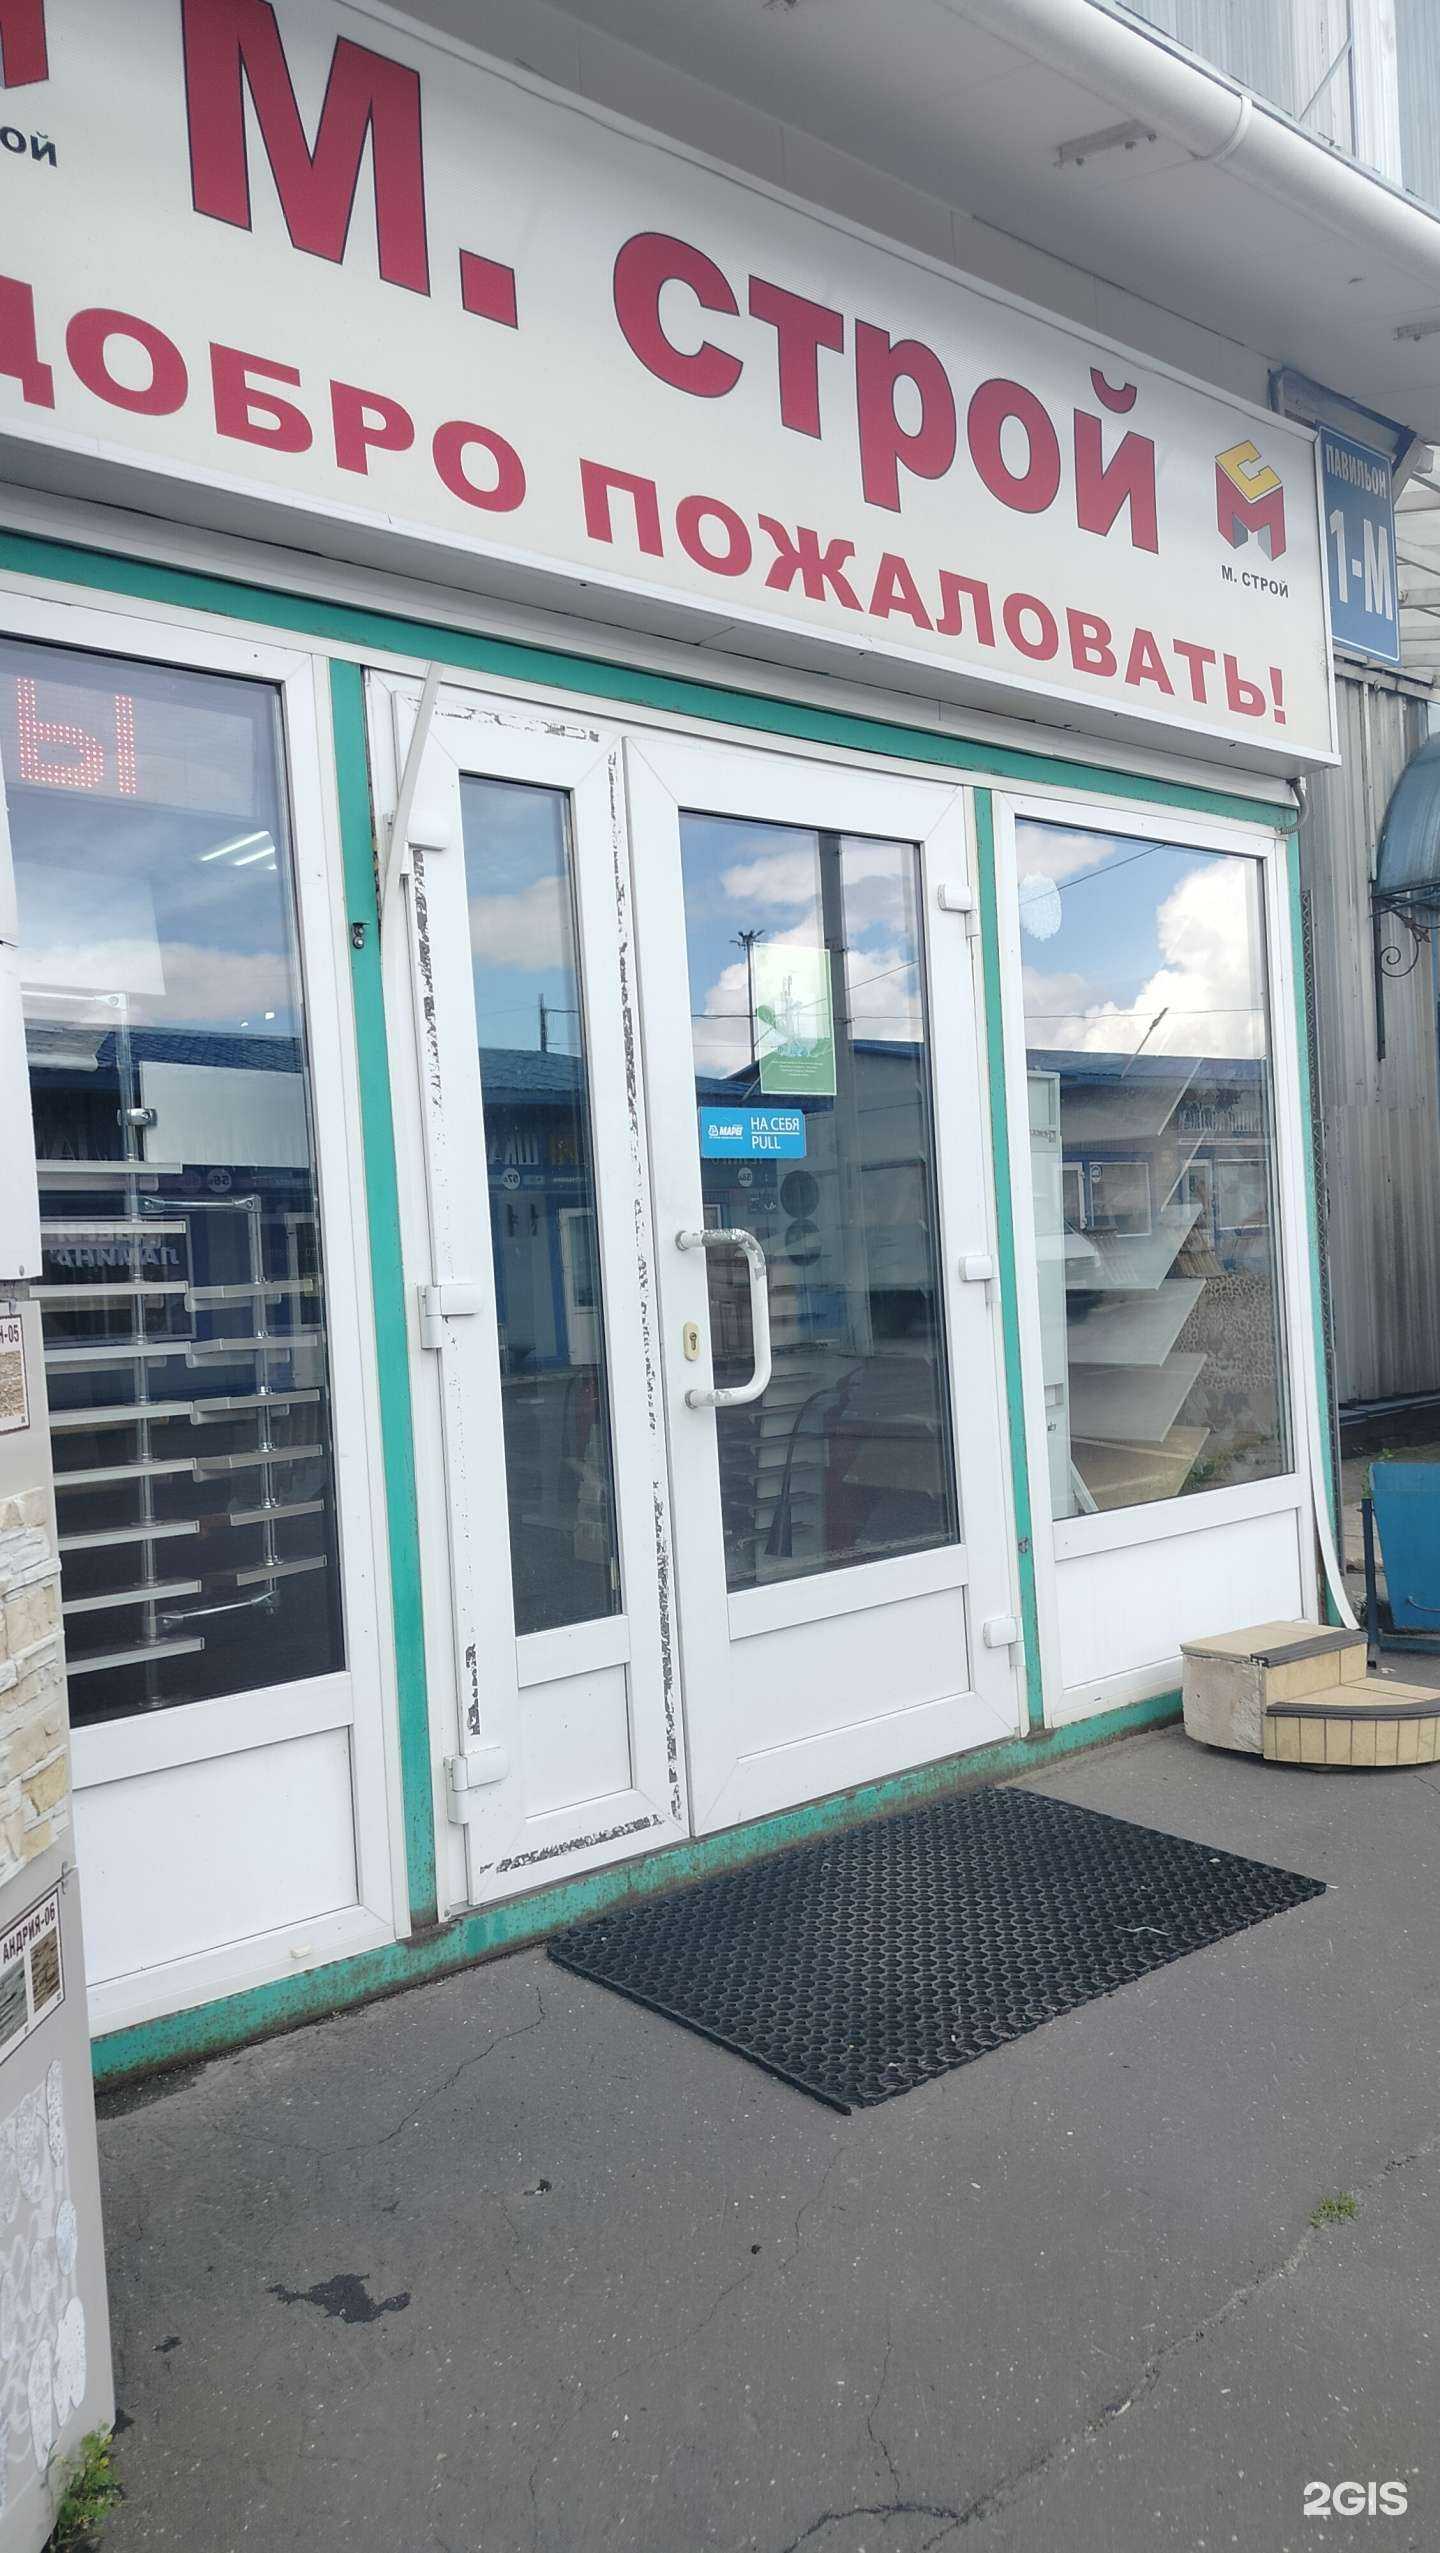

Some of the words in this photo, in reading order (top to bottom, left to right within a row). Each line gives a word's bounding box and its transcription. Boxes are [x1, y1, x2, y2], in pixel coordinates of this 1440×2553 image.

[180, 0, 518, 329] М.
[613, 231, 1159, 555] строй
[1326, 445, 1387, 499] ПАВИЛЬОН
[579, 457, 1286, 724] ПОЖАЛОВАТЬ!
[1221, 565, 1237, 583] М.
[1241, 571, 1289, 598] СТРОЙ
[1329, 509, 1393, 621] 1-М
[750, 1117, 767, 1131] НА
[771, 1118, 800, 1132] СЕБЯ
[751, 1136, 781, 1149] PULL
